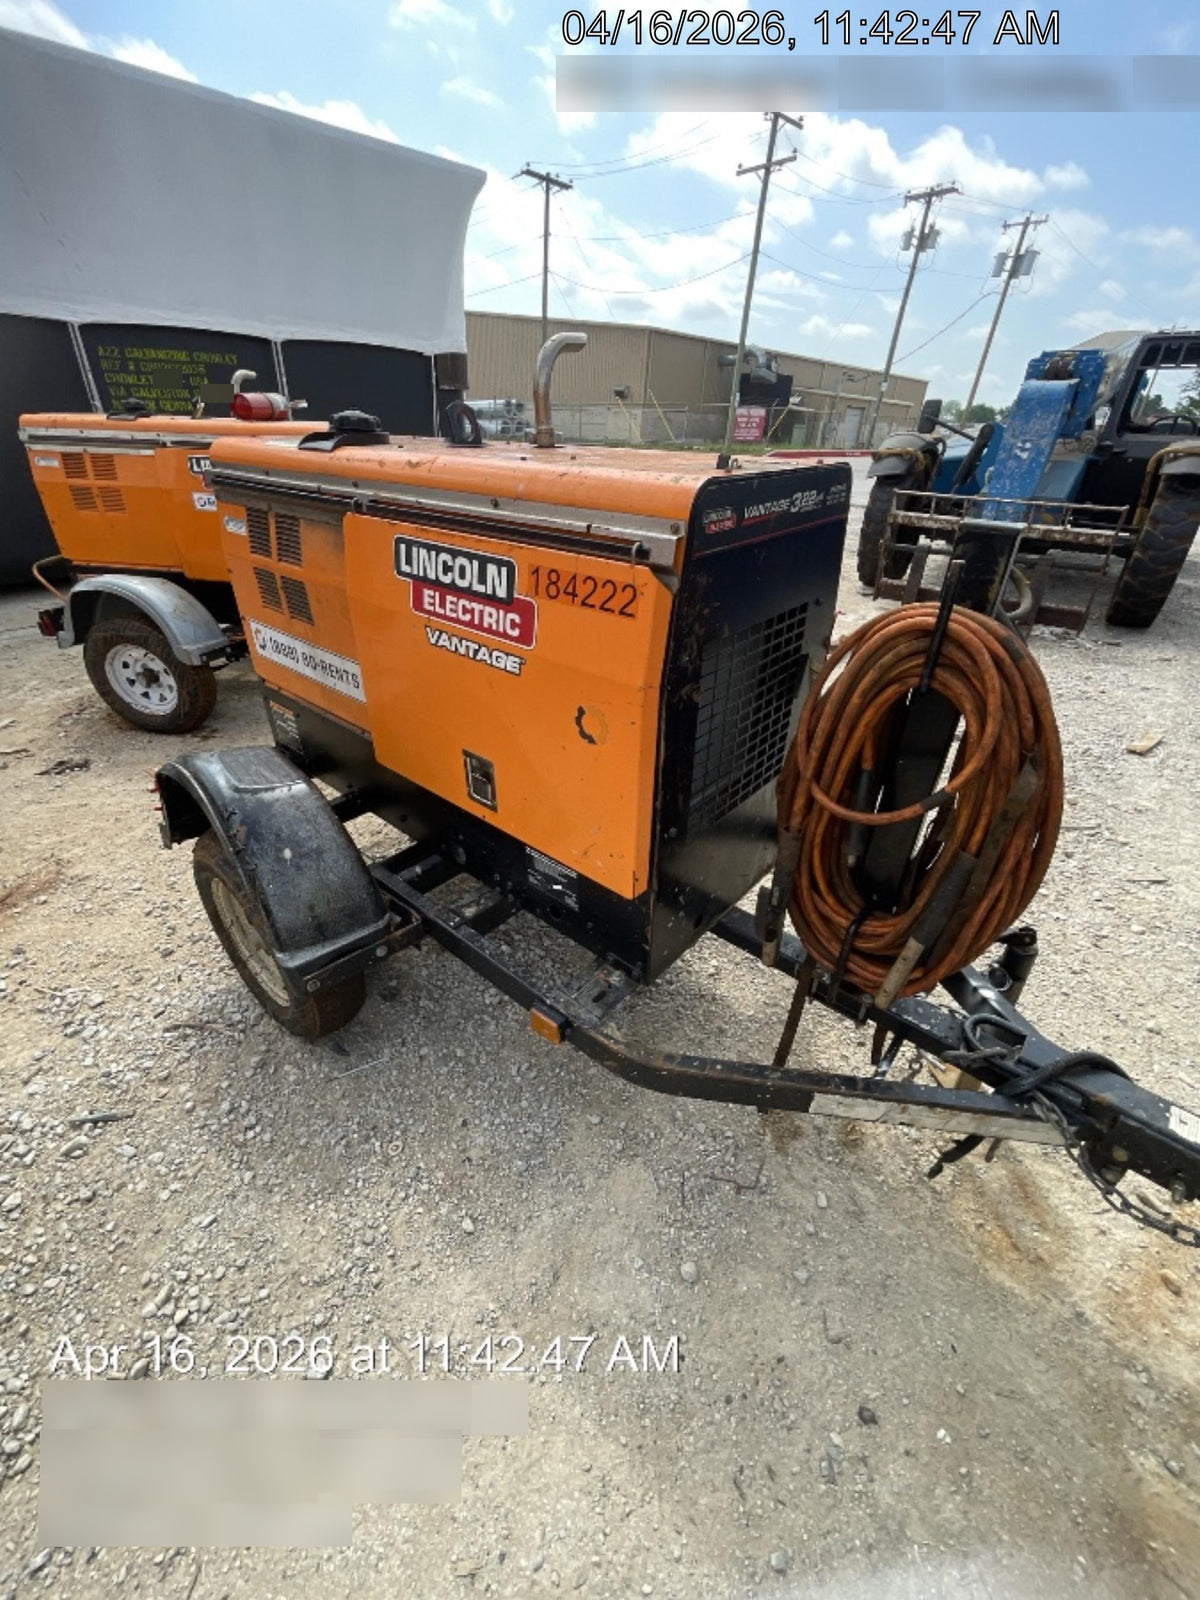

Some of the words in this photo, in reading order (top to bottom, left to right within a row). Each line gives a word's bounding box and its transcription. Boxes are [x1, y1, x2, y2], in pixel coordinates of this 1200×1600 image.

[399, 542, 508, 599] LINCOLN
[530, 565, 638, 619] 184222
[422, 588, 521, 638] ELECTRIC
[424, 624, 522, 677] VANTAGE
